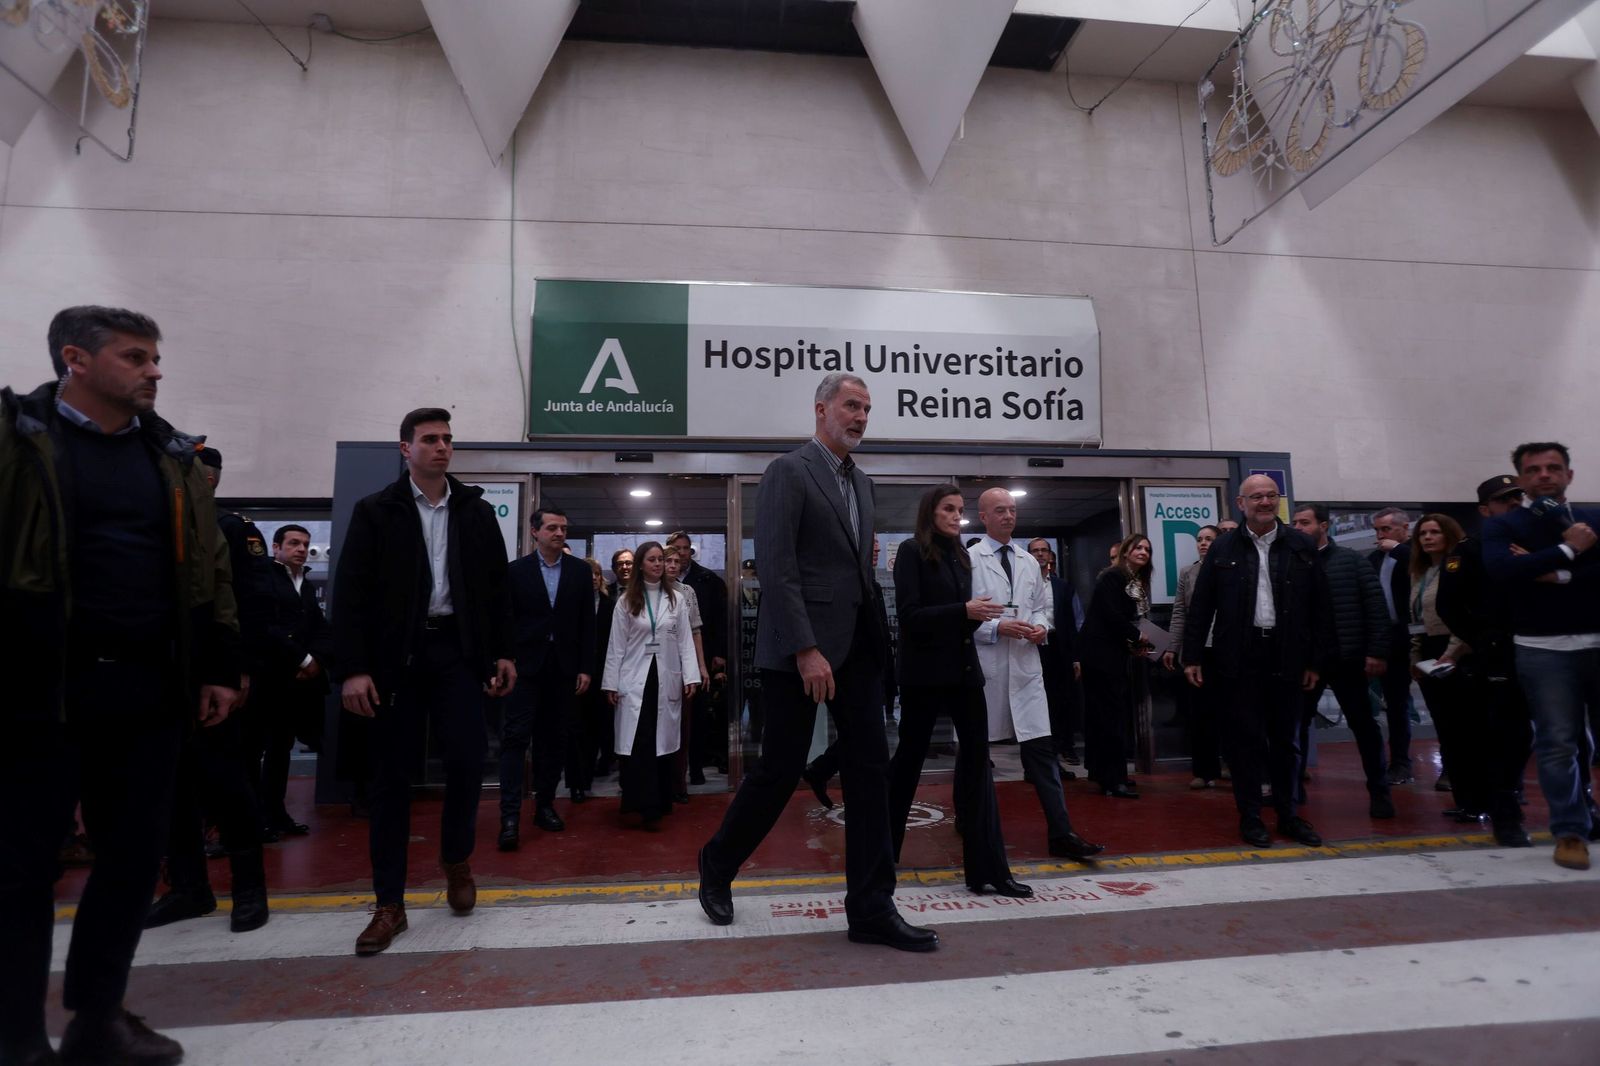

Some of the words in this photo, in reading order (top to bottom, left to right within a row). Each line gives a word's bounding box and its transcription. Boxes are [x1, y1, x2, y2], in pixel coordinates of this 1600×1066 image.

[704, 339, 855, 378] Hospital
[864, 343, 1084, 379] Universitario
[543, 399, 584, 412] Junta
[586, 400, 604, 412] de
[606, 399, 674, 413] Andalucía
[897, 387, 992, 420] Reina
[1001, 386, 1084, 421] Sofía
[1154, 502, 1211, 519] Acceso
